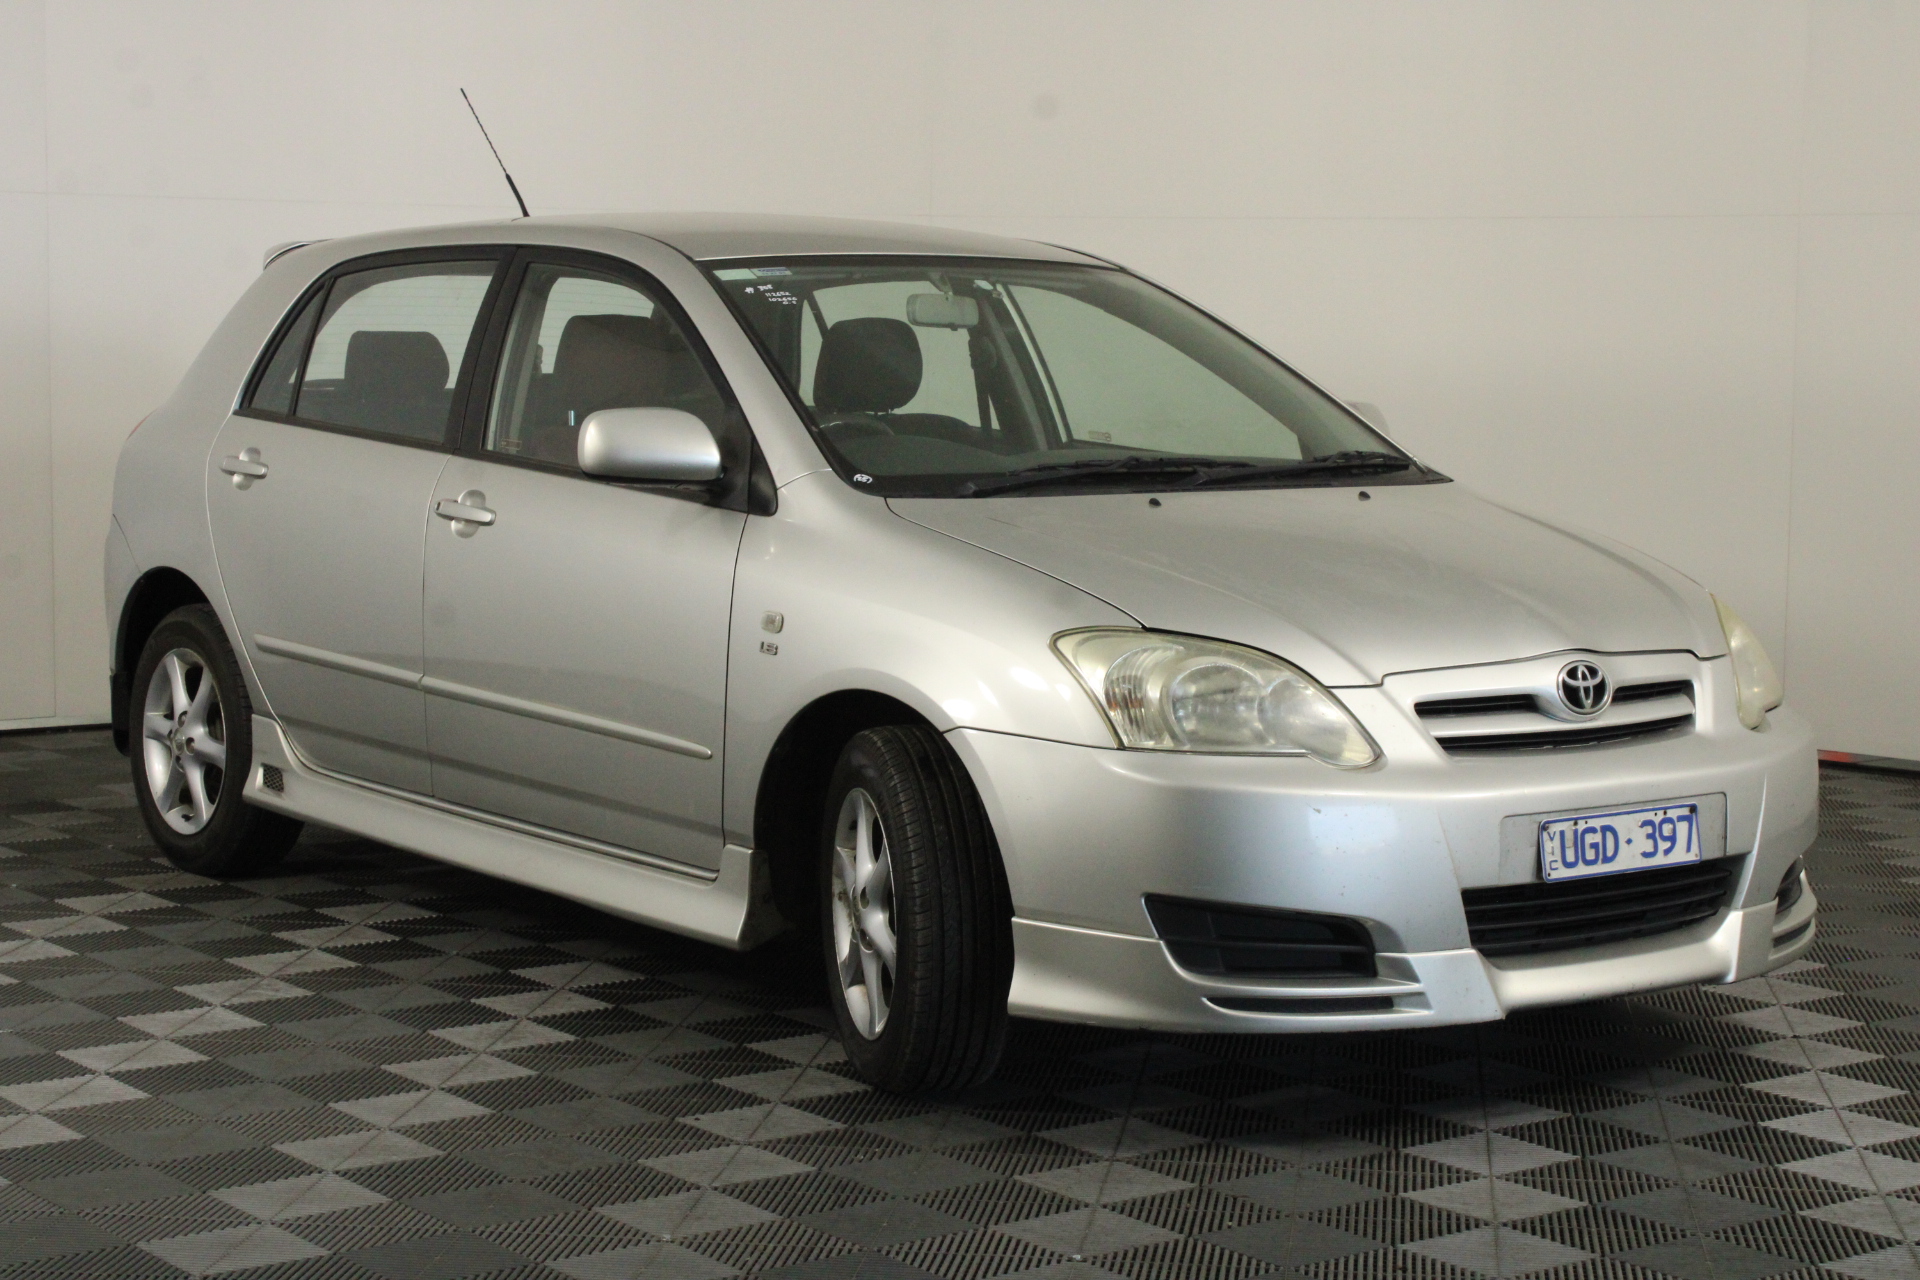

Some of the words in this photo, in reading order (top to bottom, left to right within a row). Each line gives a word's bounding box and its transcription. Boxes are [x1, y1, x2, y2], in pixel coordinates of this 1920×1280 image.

[1547, 830, 1558, 871] VIC
[1559, 824, 1621, 869] UGD
[1640, 814, 1695, 859] 397
